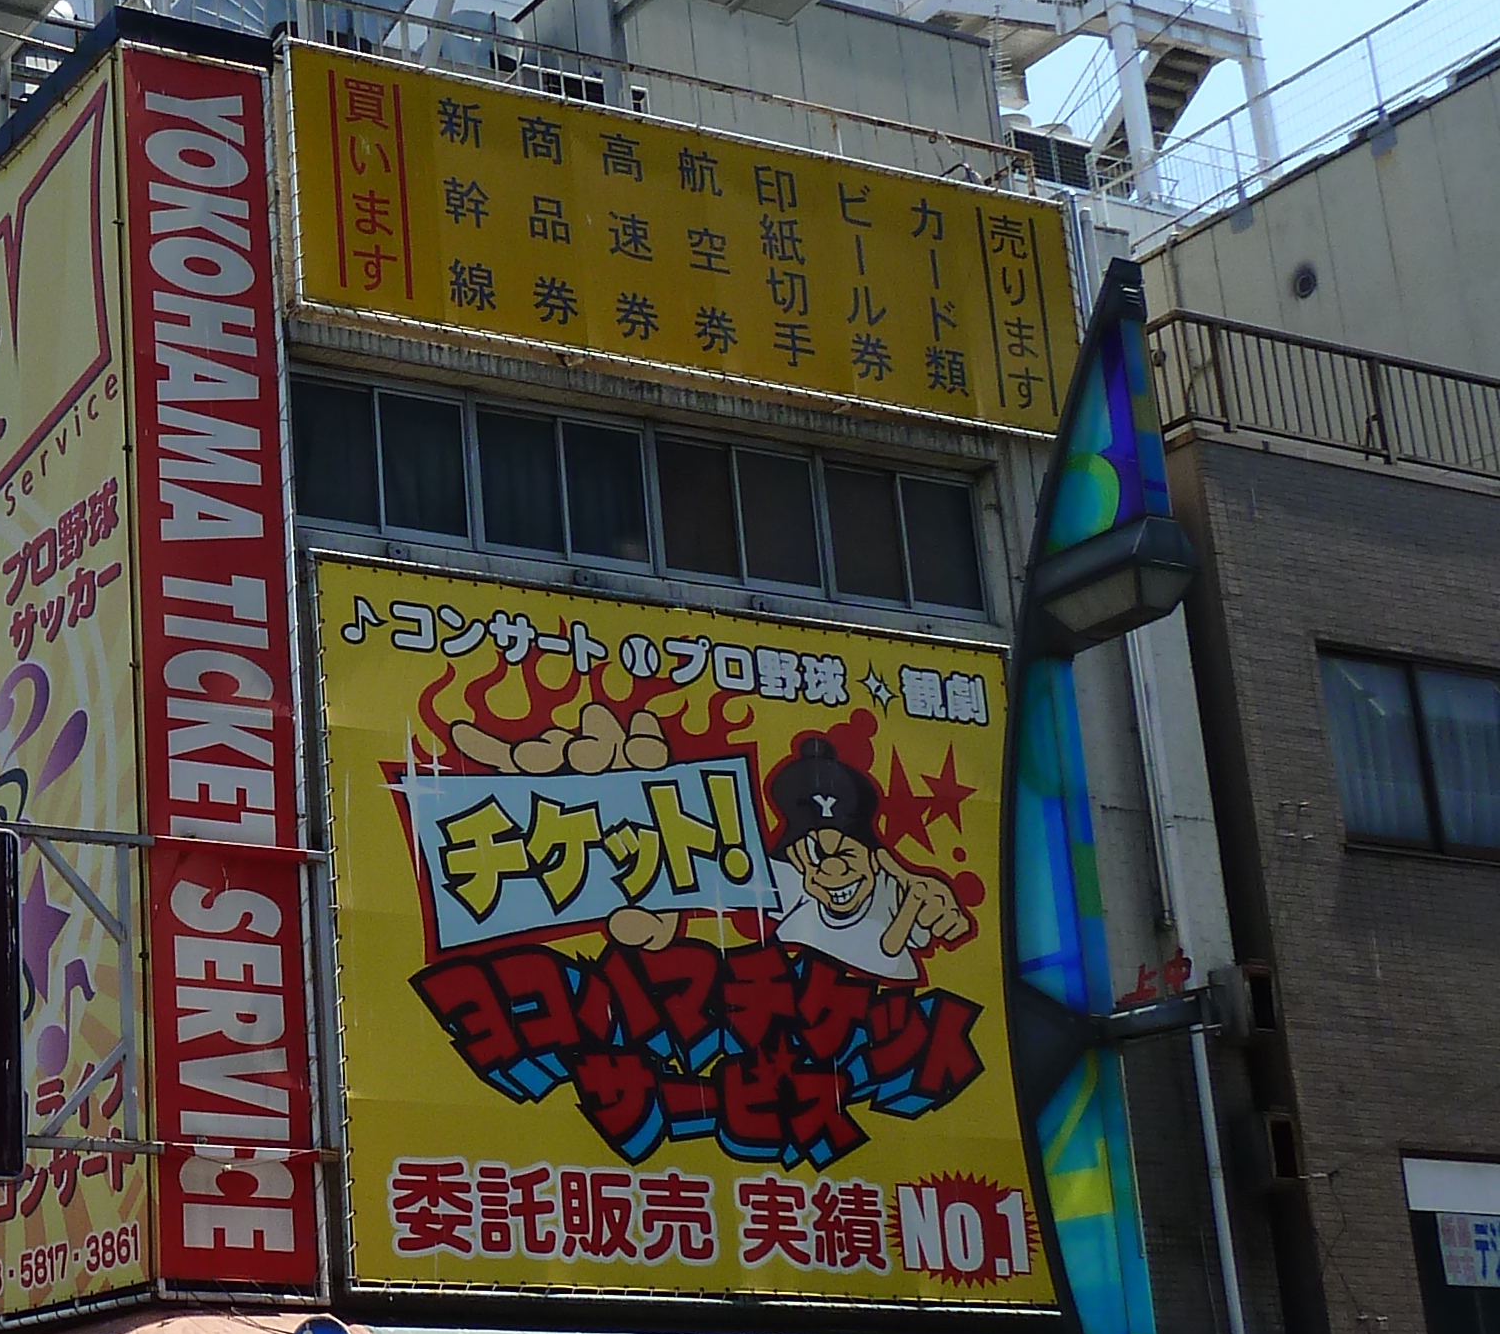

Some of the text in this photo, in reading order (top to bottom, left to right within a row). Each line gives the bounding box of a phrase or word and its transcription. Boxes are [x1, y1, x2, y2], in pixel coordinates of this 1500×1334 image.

[344, 77, 399, 293] 買います
[436, 98, 497, 313] 新幹線
[520, 115, 579, 325] 商品券
[598, 132, 660, 341] 高速券
[677, 146, 739, 355] 航空券
[754, 164, 816, 368] 印紙切手
[836, 181, 894, 383] ビール券
[909, 198, 971, 398] カード類
[987, 214, 1045, 413] 売ります
[2, 475, 120, 608] プロ野球
[3, 372, 121, 518] Service
[8, 561, 123, 661] サッカー
[139, 92, 296, 1256] YOKOHAMA TICKET SERVICE
[390, 601, 989, 726] コンサート プロ野球 観劇
[443, 771, 752, 924] チケット!
[811, 793, 838, 817] Y
[410, 945, 986, 1097] ヨコハマチケット
[578, 1045, 868, 1157] サービス
[391, 1158, 717, 1265] 委託販売
[738, 1175, 891, 1272] 実績
